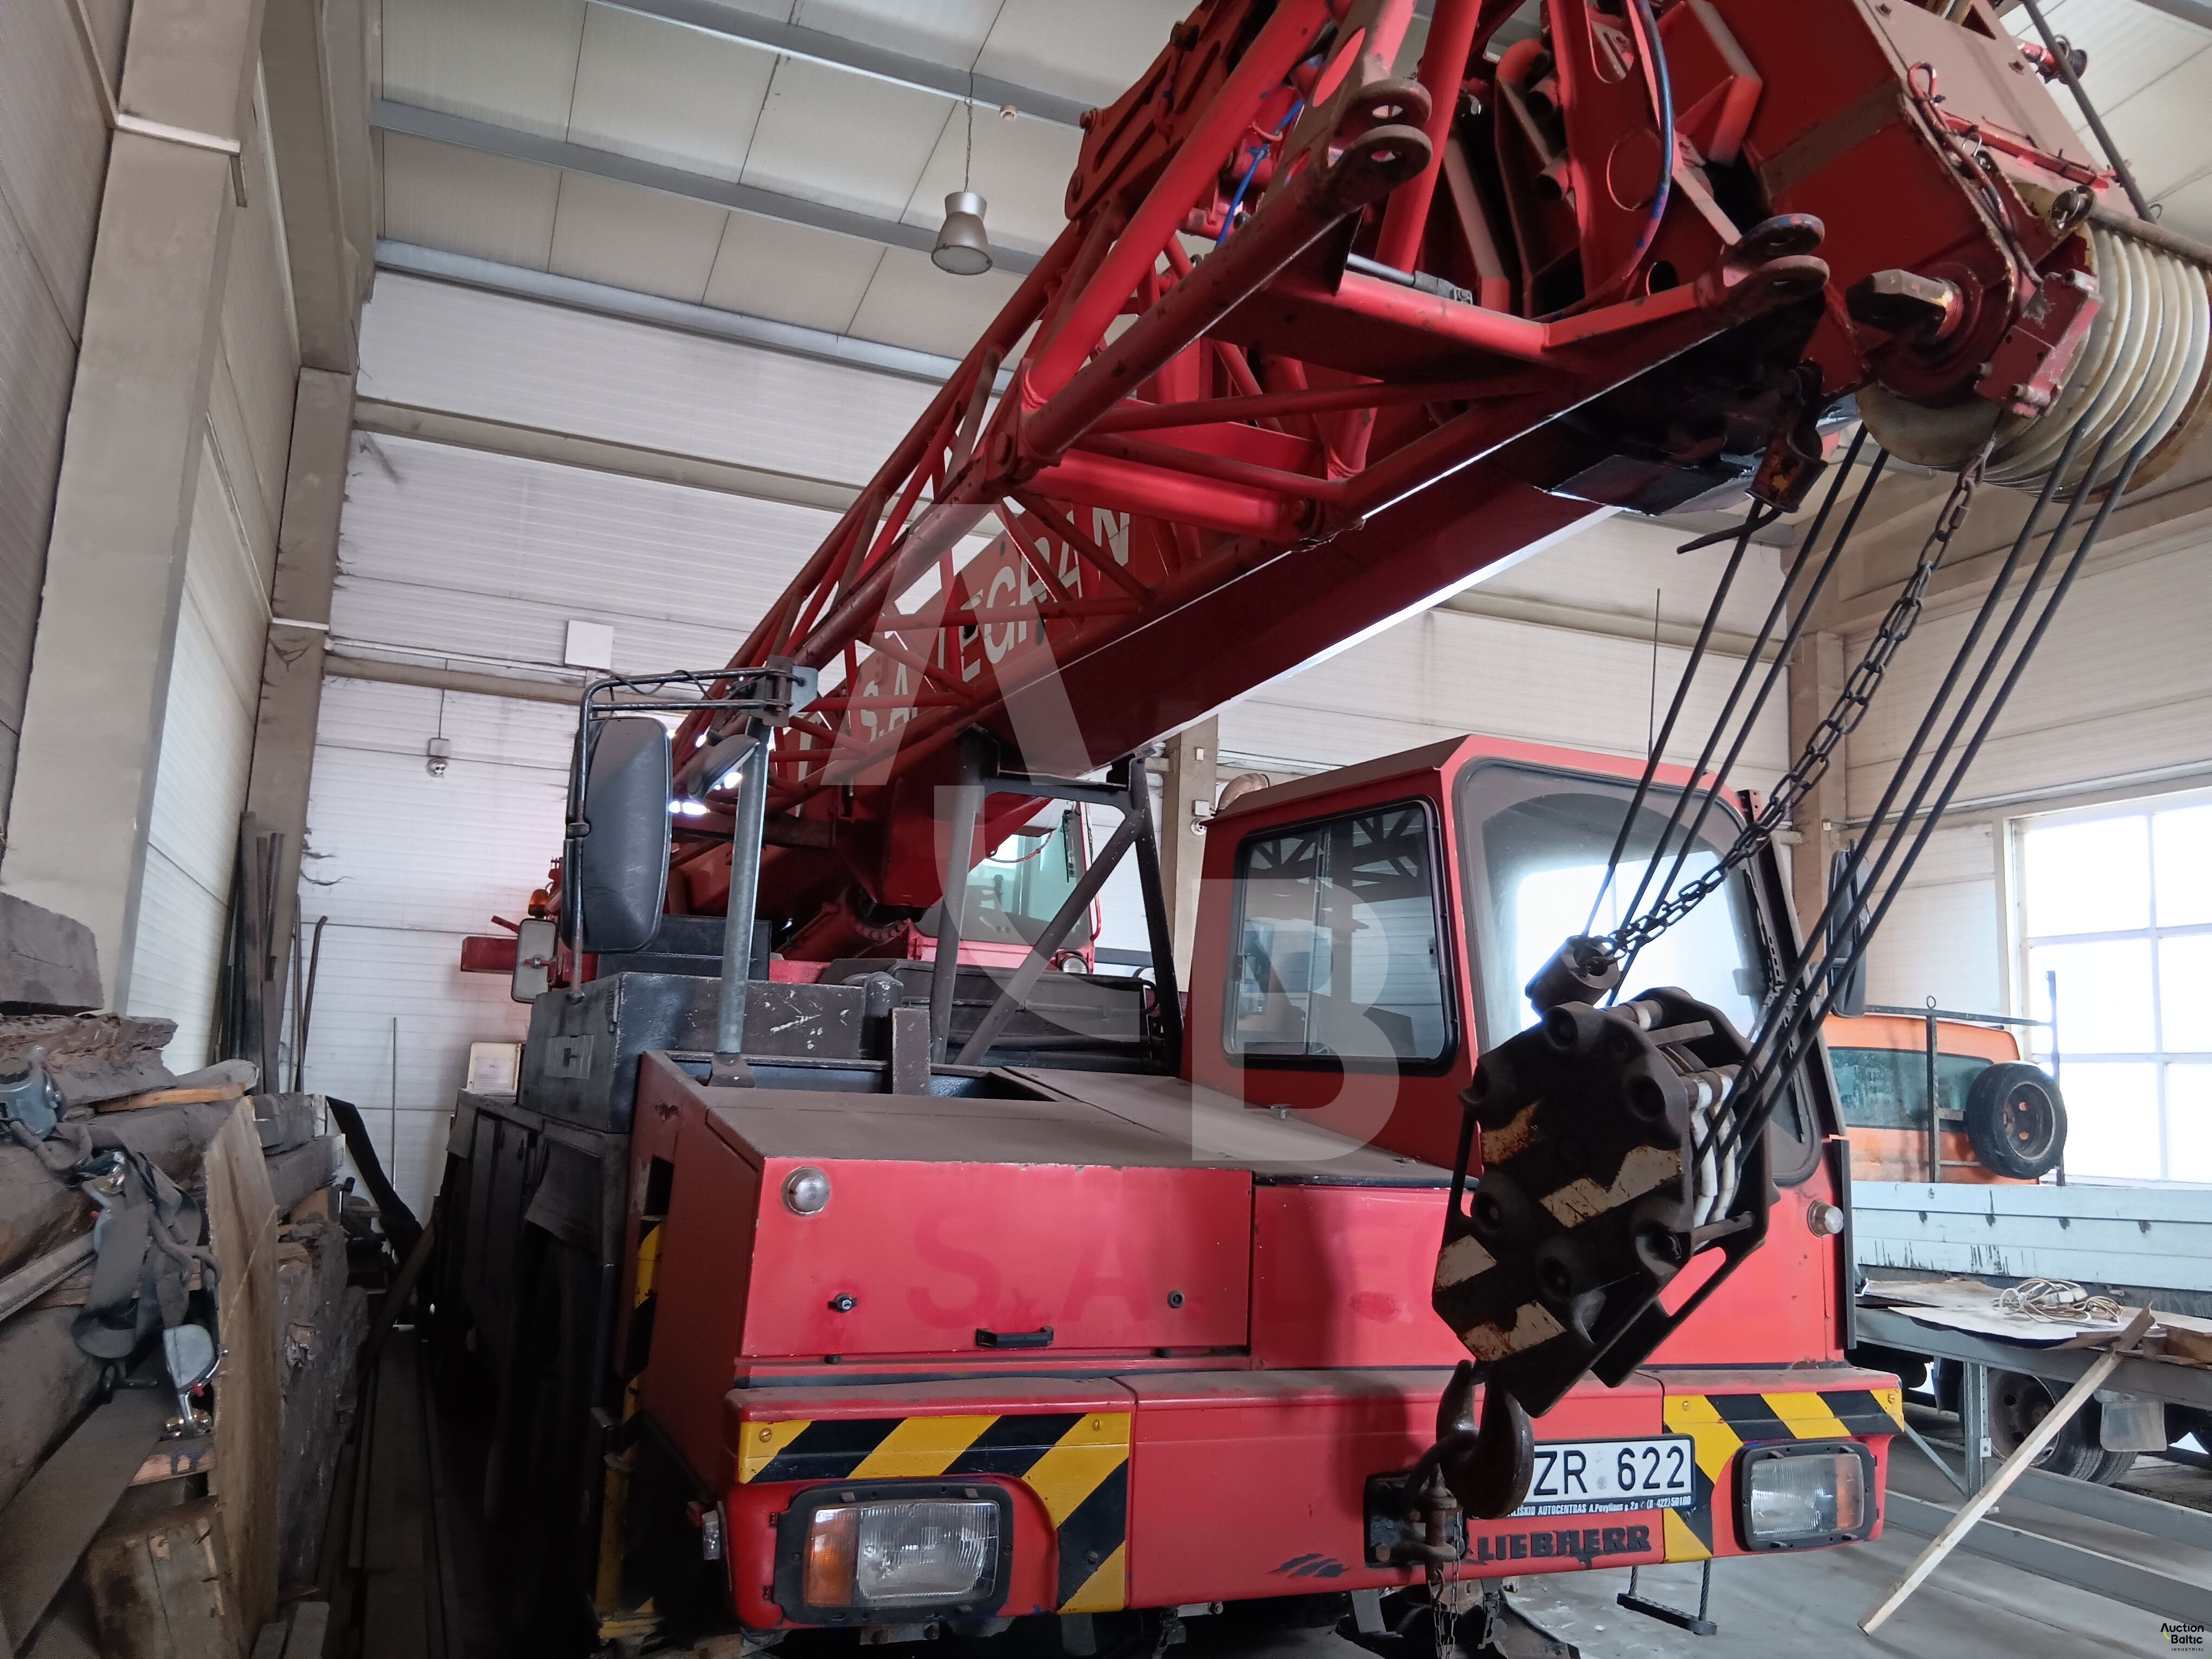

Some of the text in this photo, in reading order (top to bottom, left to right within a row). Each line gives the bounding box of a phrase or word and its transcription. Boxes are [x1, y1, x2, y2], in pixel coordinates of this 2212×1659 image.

[1617, 1445, 1684, 1491] 622
[1538, 1503, 1587, 1516] AUTOCENTRAS
[1477, 1525, 1652, 1561] LIEBHERR
